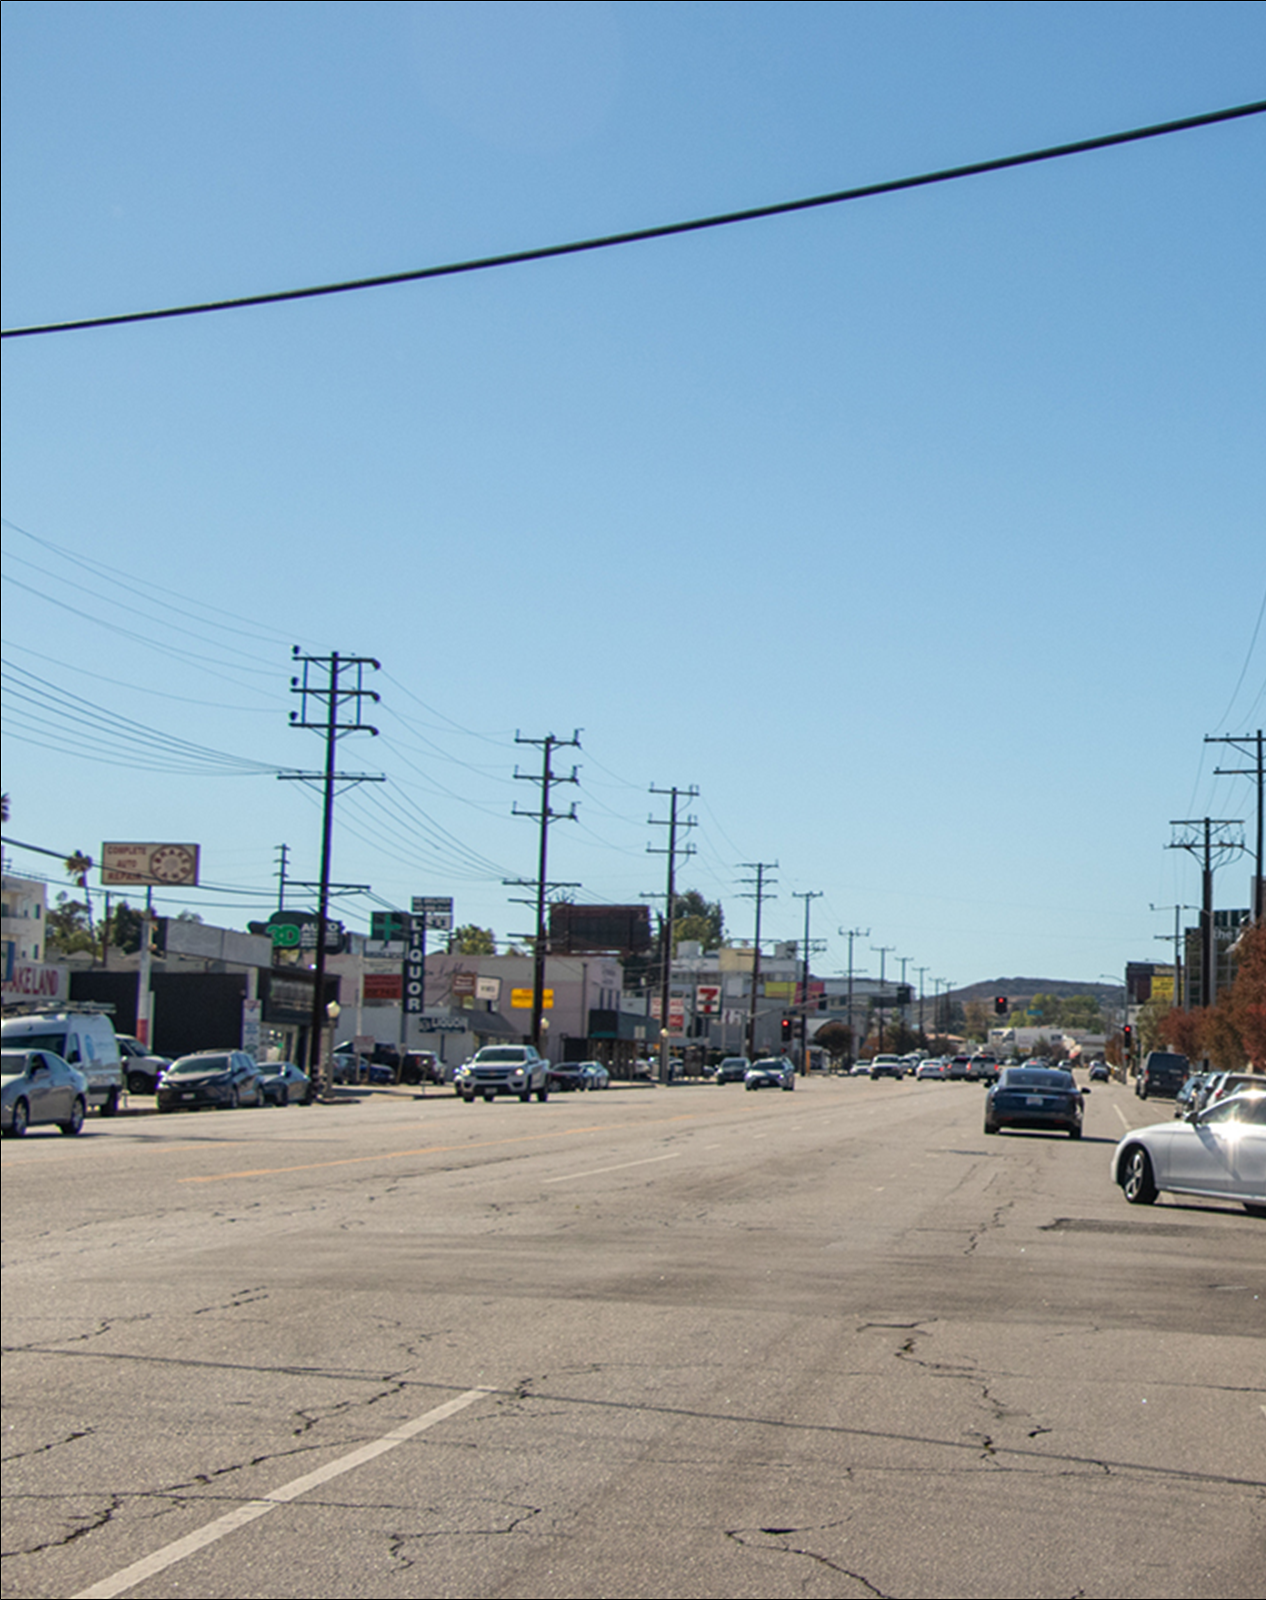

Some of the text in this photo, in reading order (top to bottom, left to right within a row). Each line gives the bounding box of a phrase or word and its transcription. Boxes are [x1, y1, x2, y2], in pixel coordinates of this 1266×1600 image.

[266, 923, 300, 947] 3D
[301, 922, 339, 932] AUO
[407, 918, 423, 1011] LIQUOR
